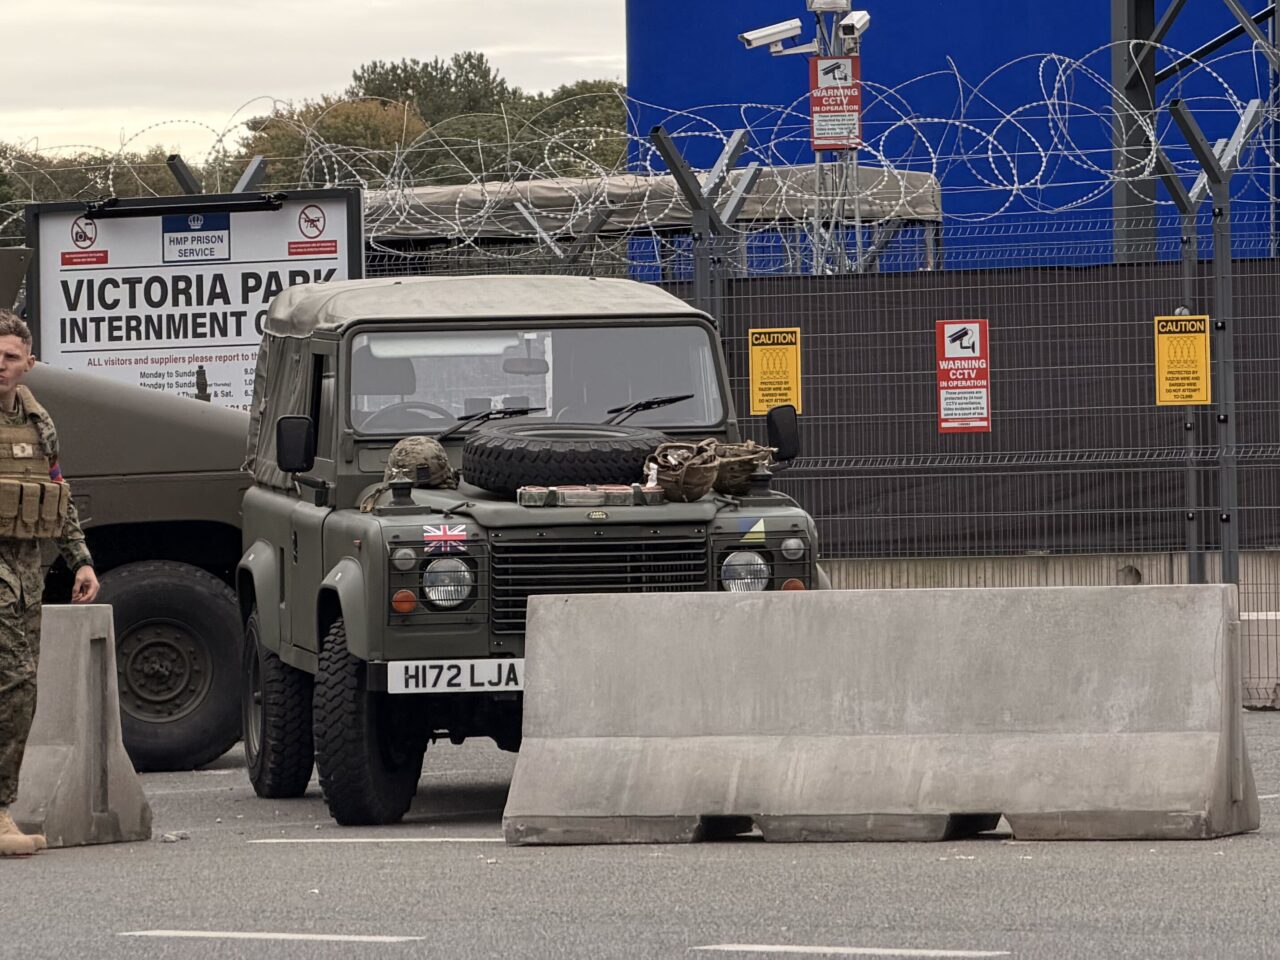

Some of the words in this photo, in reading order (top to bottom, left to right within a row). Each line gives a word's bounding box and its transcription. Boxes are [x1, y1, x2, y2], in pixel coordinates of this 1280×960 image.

[812, 88, 858, 97] WARNING
[822, 96, 849, 105] CCTV
[169, 236, 189, 245] HMP
[191, 235, 224, 245] PRISON
[178, 247, 215, 258] SERVICE
[60, 273, 231, 311] VICTORIA
[60, 311, 247, 344] INTERNMENT
[1159, 321, 1204, 332] CAUTION
[752, 333, 795, 344] CAUTION
[87, 358, 102, 366] ALL
[104, 357, 132, 366] visitors
[134, 356, 149, 365] and
[150, 356, 186, 367] suppliers
[188, 355, 213, 365] please
[214, 354, 239, 364] report
[939, 359, 986, 369] WARNING
[140, 371, 165, 380] Monday
[175, 370, 196, 378] Sunda
[949, 369, 977, 379] CCTV
[167, 381, 173, 389] to
[175, 381, 196, 389] Sunda
[404, 664, 462, 688] H172
[470, 663, 519, 687] LJA
